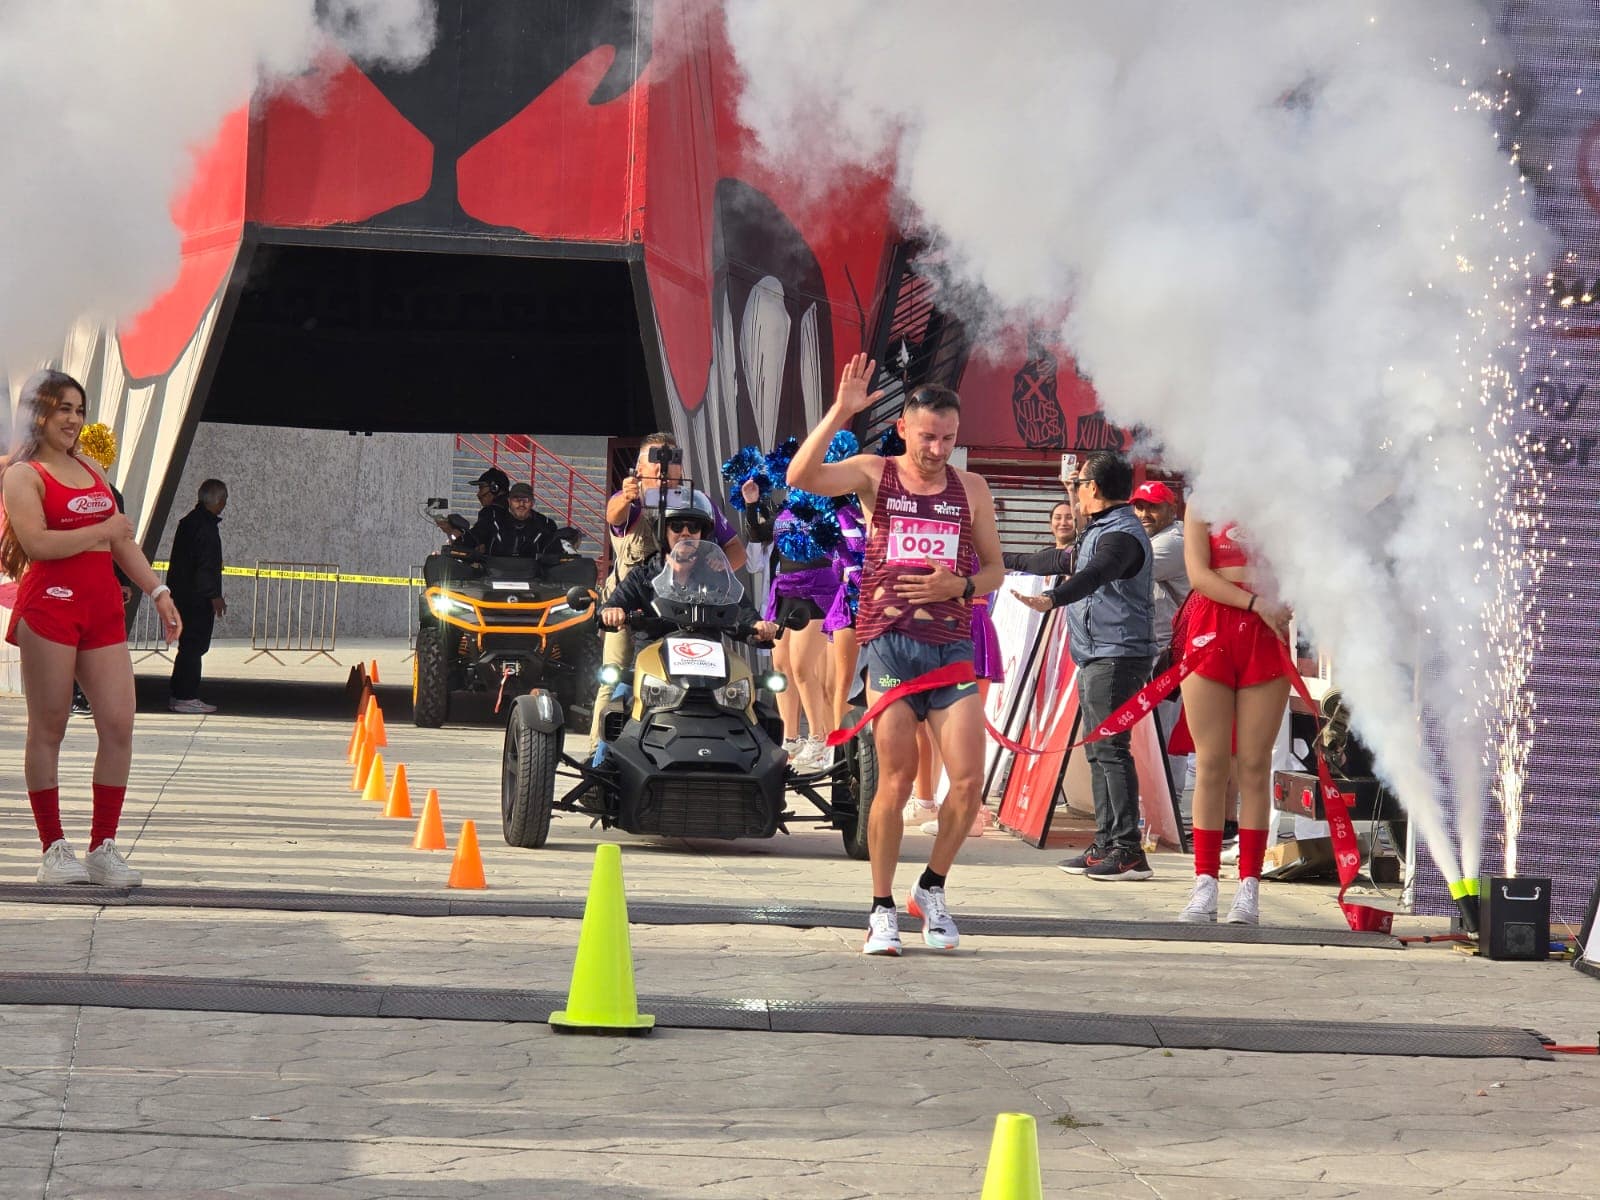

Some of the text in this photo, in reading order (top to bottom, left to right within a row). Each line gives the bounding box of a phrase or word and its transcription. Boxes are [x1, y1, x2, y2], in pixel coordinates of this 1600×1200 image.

[76, 498, 107, 511] Roma
[886, 495, 918, 513] molina
[902, 536, 945, 556] 002
